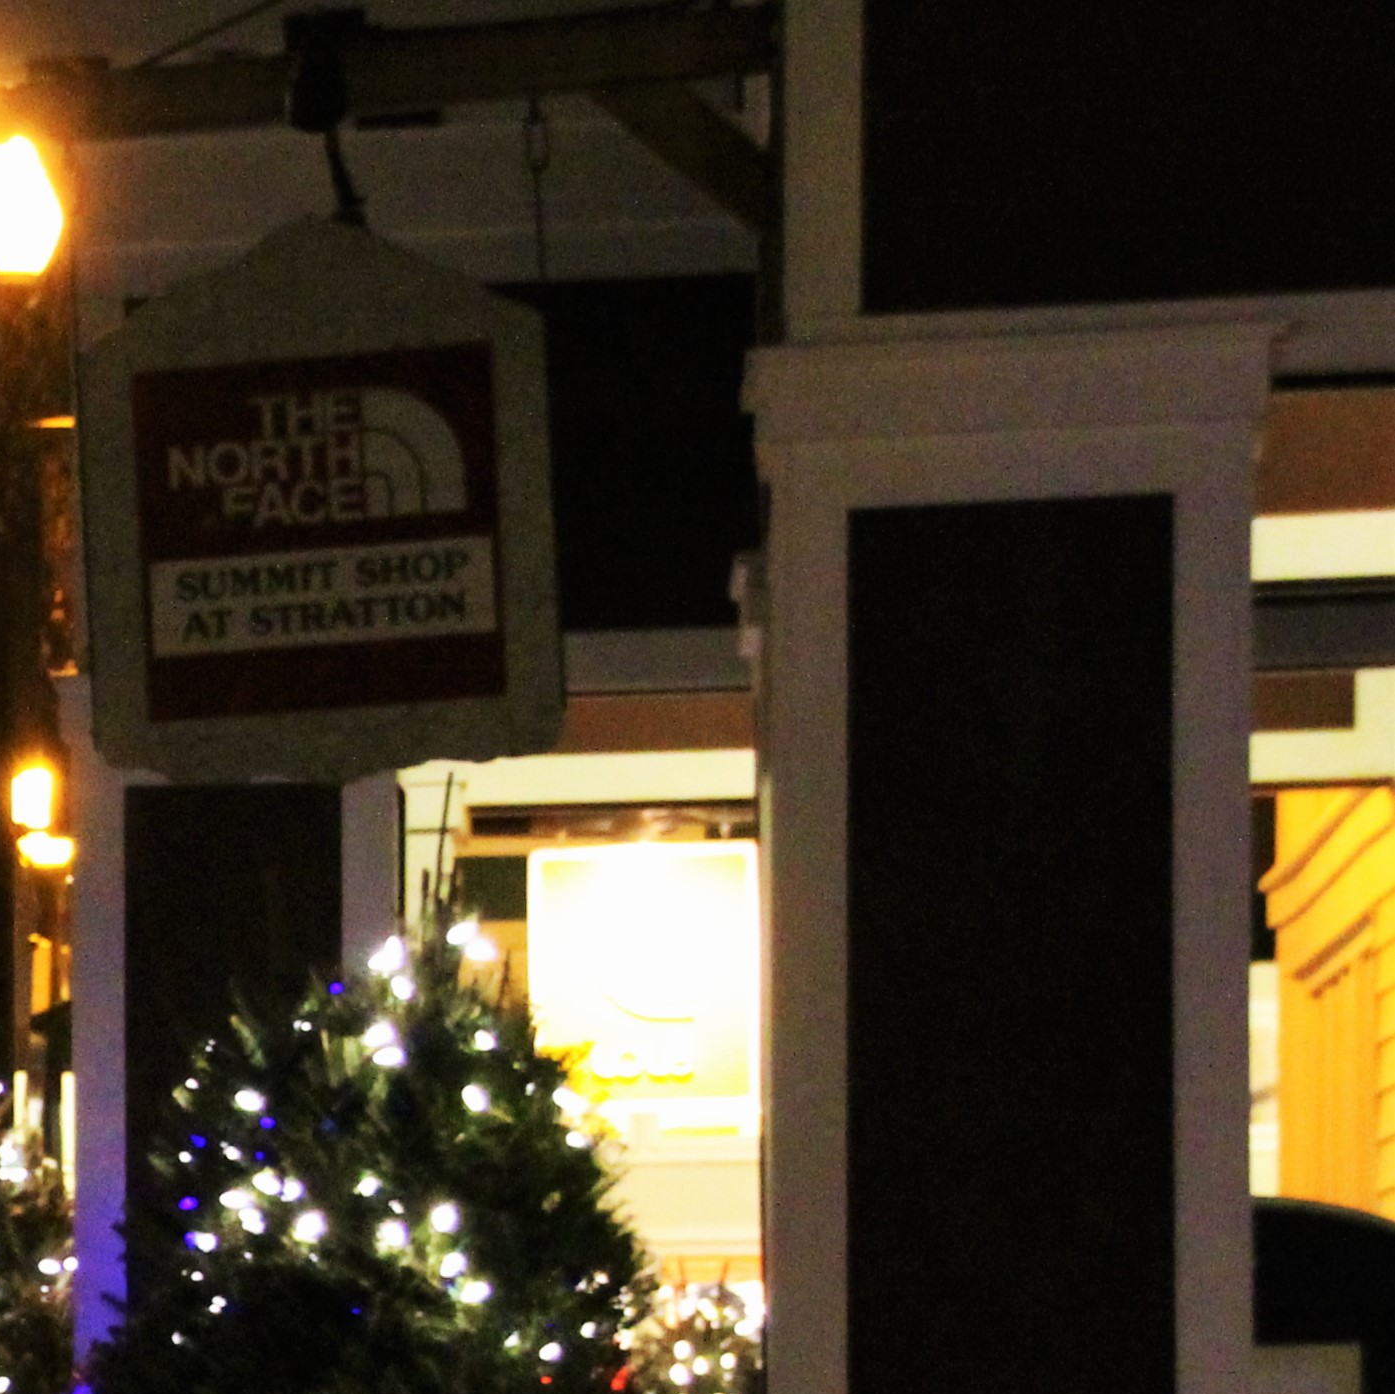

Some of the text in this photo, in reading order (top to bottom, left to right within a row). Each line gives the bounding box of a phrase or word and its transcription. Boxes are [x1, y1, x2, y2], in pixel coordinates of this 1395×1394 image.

[247, 389, 361, 442] THE
[167, 430, 362, 491] NORTH
[222, 476, 364, 531] FACE
[177, 549, 468, 601] SUMMIT SHOP
[182, 593, 465, 643] AT STRATTON
